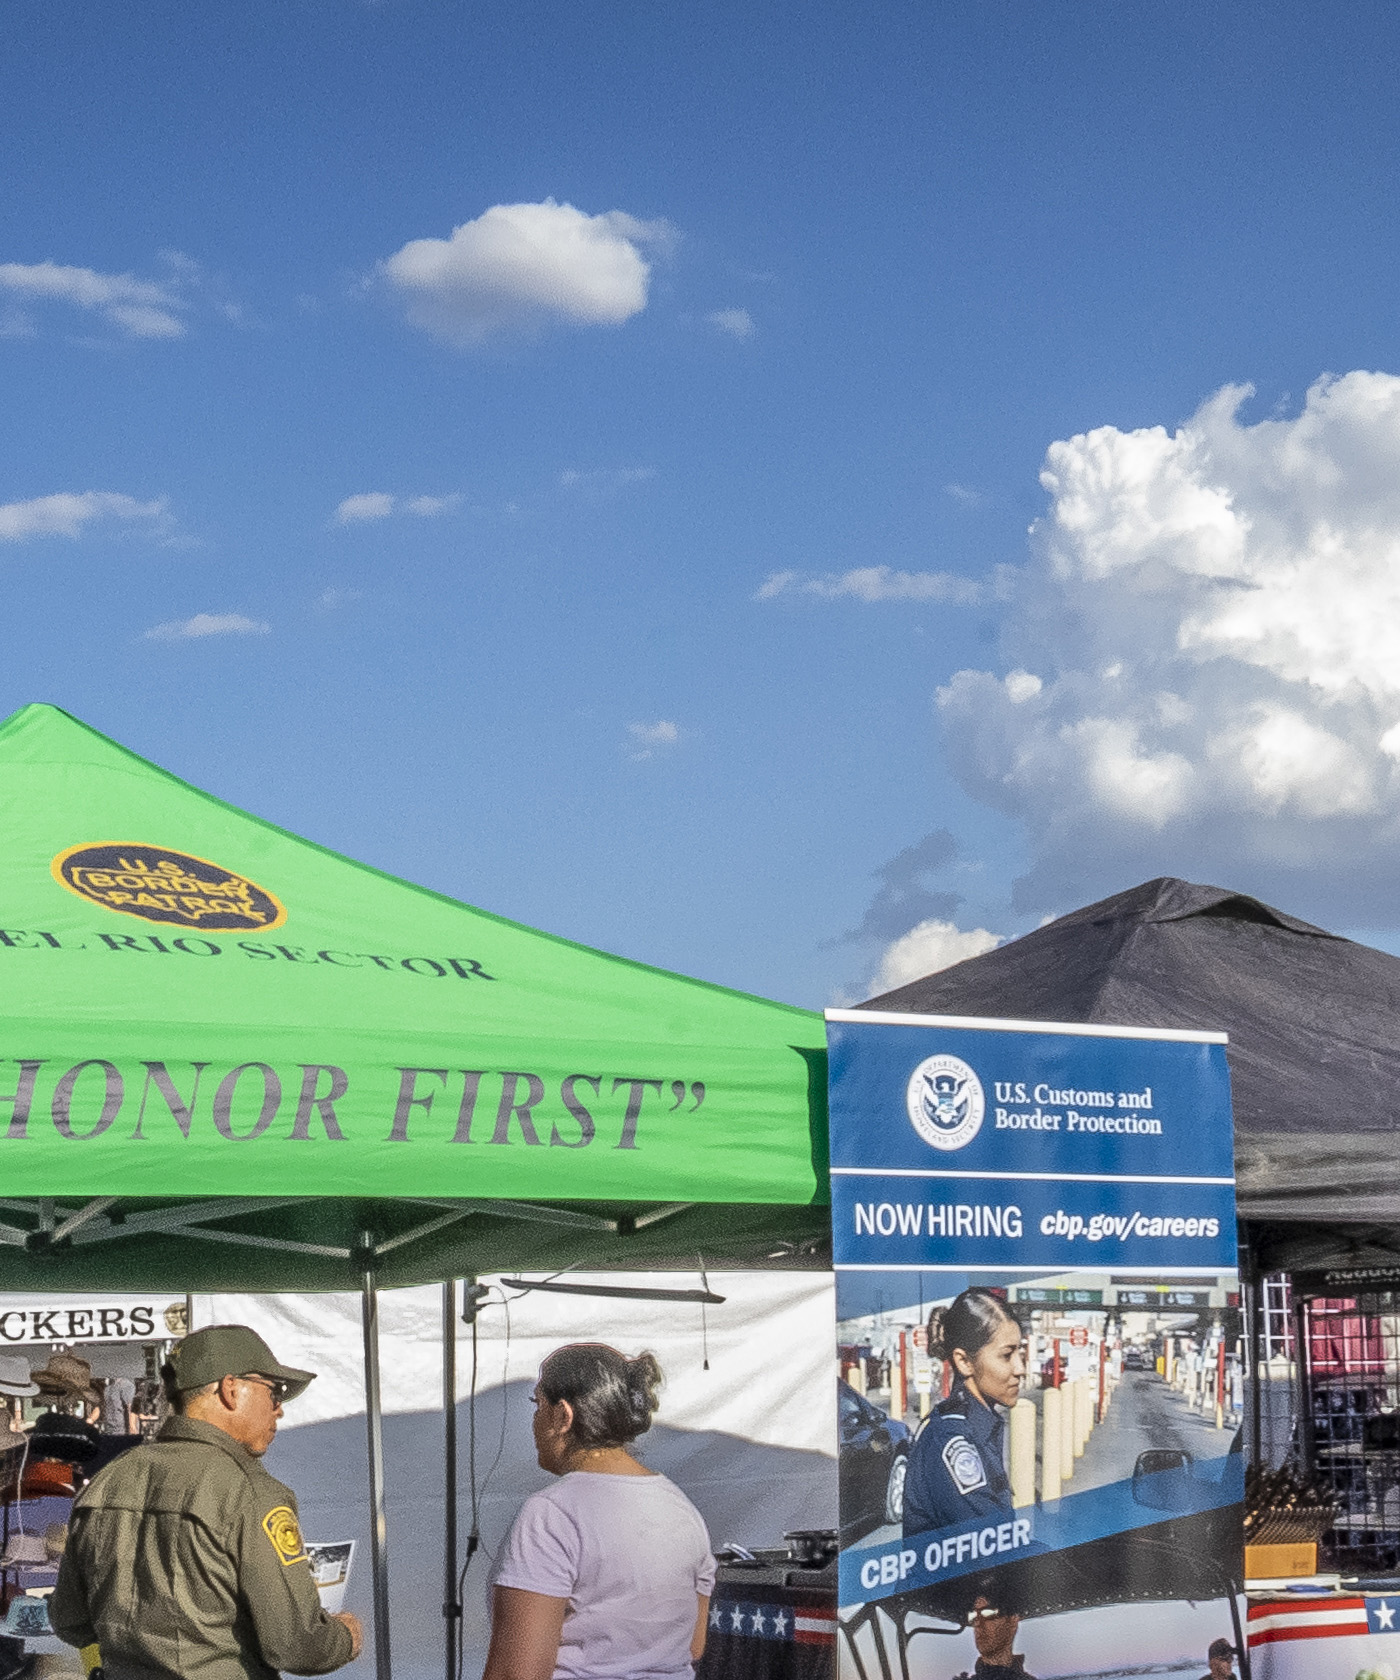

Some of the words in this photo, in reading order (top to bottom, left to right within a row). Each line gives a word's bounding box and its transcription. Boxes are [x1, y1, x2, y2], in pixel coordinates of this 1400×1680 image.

[119, 858, 196, 879] U.S.
[87, 874, 250, 899] BORDER
[108, 891, 266, 922] PATROL
[97, 932, 222, 957] RIO
[238, 940, 498, 982] SECTOR
[995, 1082, 1030, 1103] U.S.
[1034, 1084, 1114, 1108] Customs
[1119, 1088, 1152, 1108] and
[995, 1109, 1062, 1130] Border
[1068, 1112, 1162, 1135] Protection
[855, 1203, 923, 1236] NOW
[929, 1204, 1022, 1238] HIRING
[1041, 1210, 1219, 1241] cbp.gov/careers
[861, 1549, 916, 1589] CBP
[924, 1519, 1030, 1572] OFFICER
